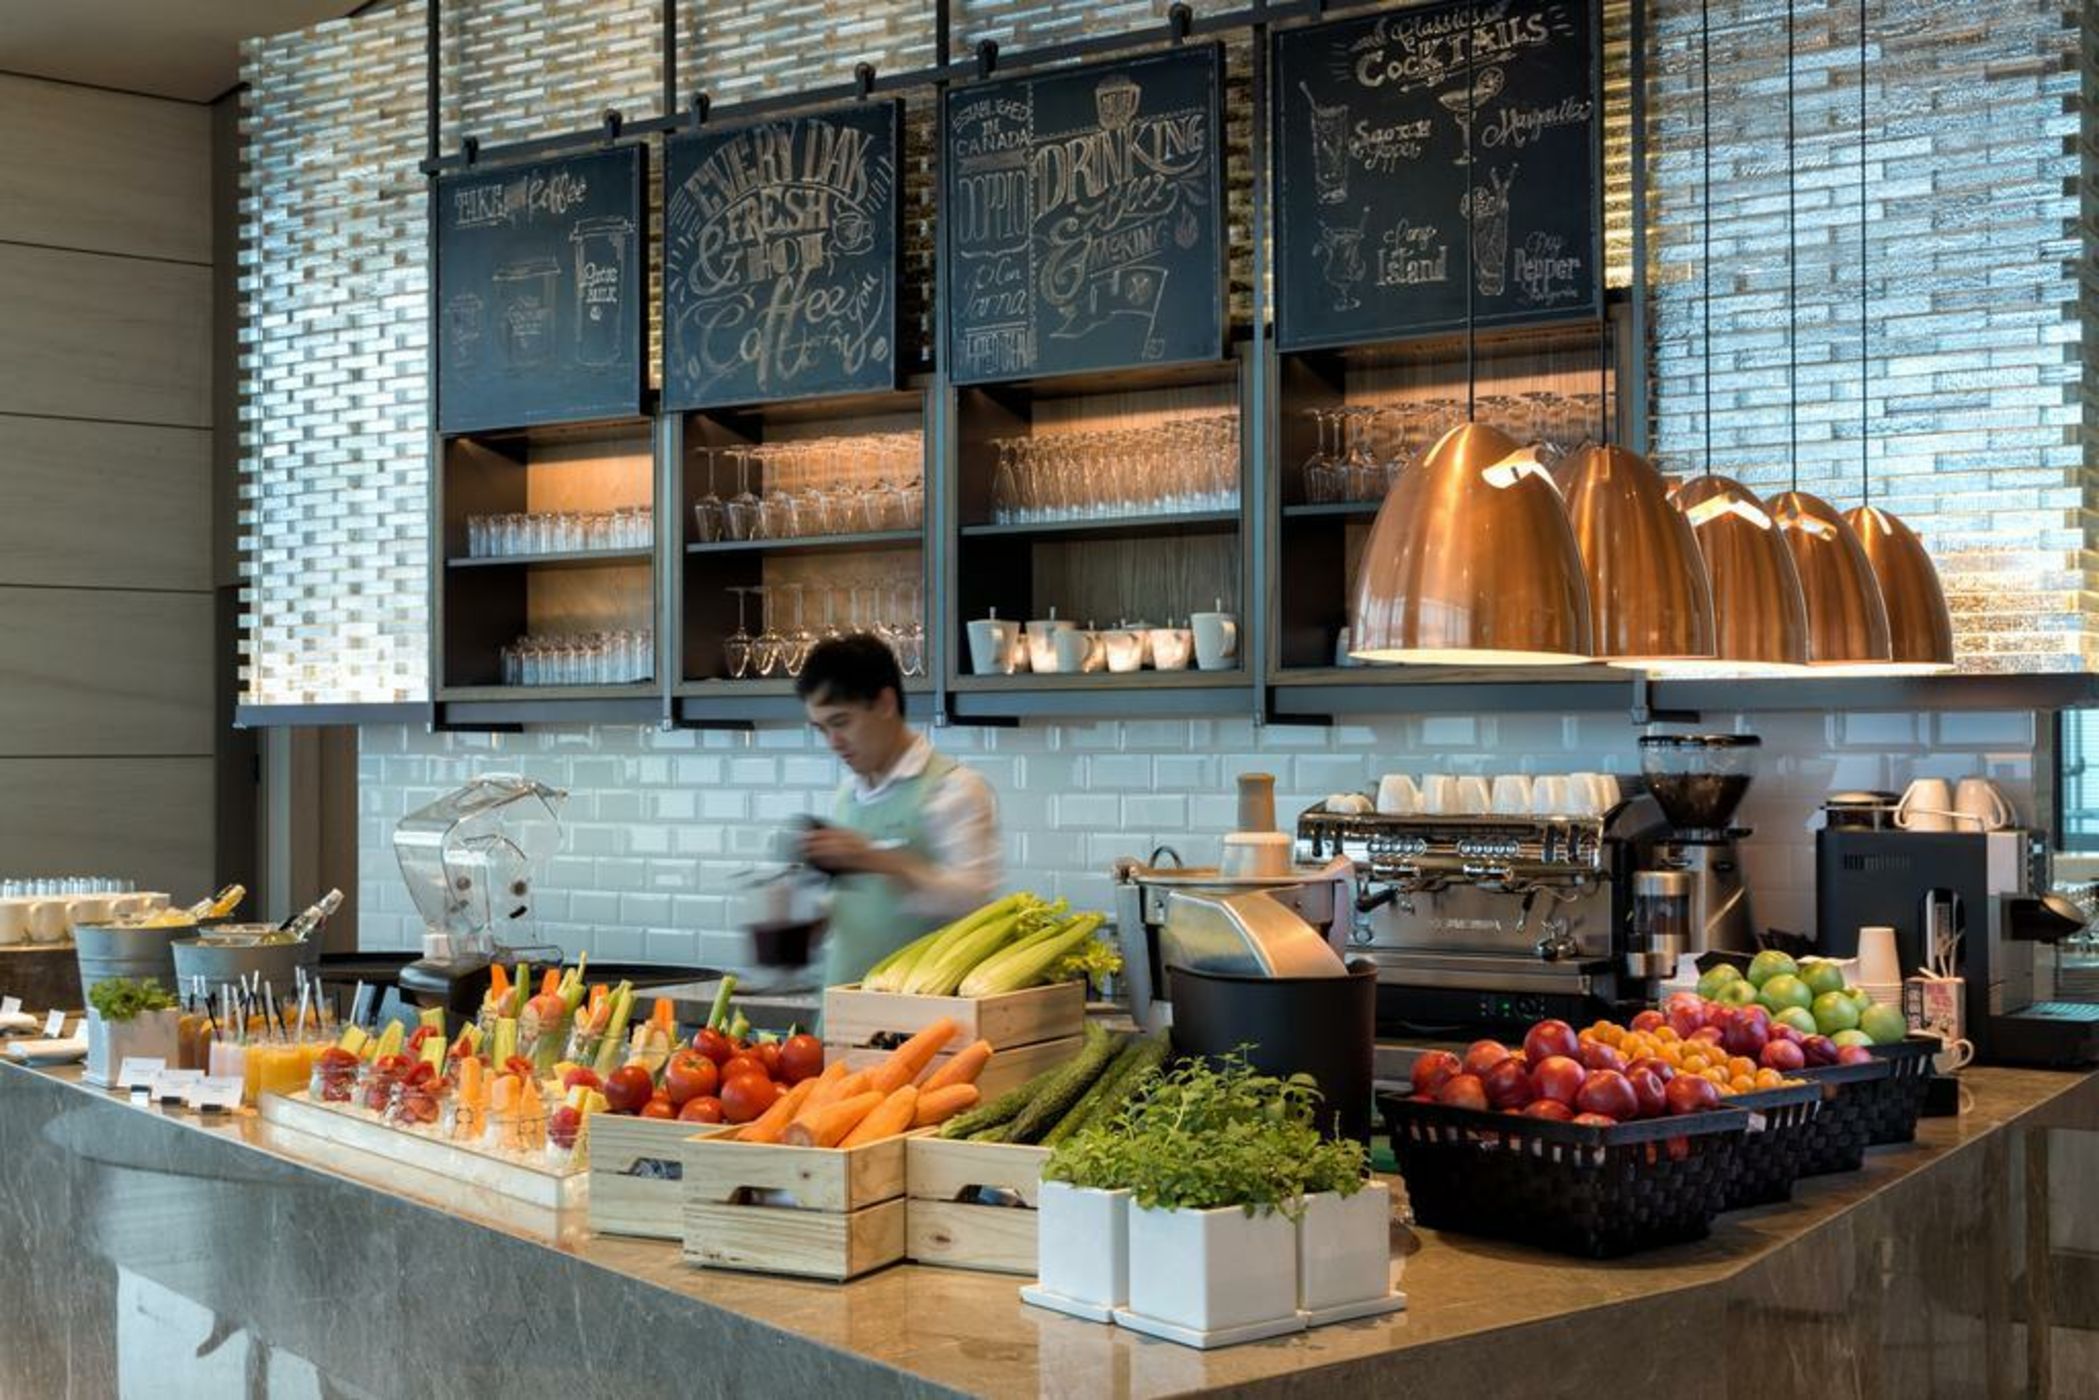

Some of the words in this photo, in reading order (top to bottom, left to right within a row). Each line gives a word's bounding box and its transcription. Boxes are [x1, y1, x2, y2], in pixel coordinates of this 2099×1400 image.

[956, 129, 1031, 155] CANADA
[1031, 112, 1204, 222] DRINKING
[726, 188, 829, 246] FRESH
